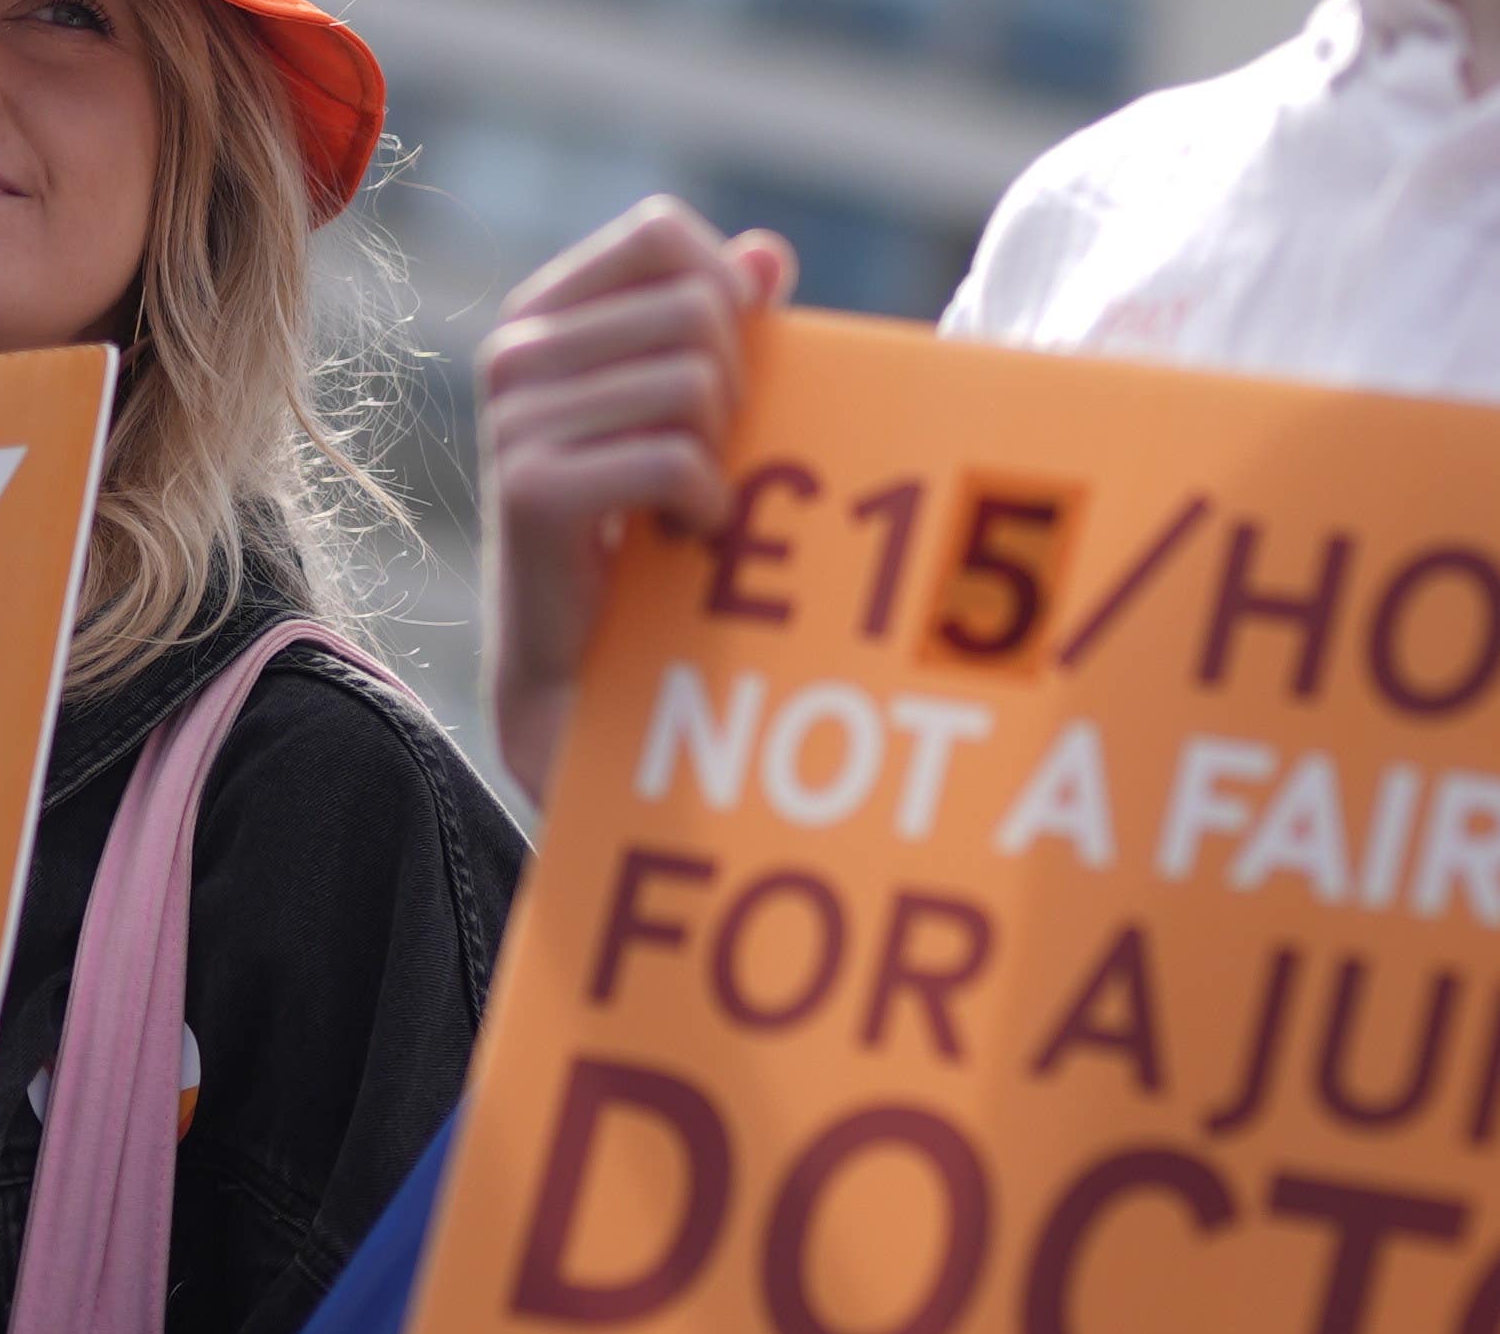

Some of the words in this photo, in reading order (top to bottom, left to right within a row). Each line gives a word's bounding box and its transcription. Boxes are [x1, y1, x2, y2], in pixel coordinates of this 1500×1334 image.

[634, 659, 994, 842] NOT
[991, 715, 1118, 875] A
[584, 845, 998, 1063] FOR
[1029, 919, 1168, 1097] A
